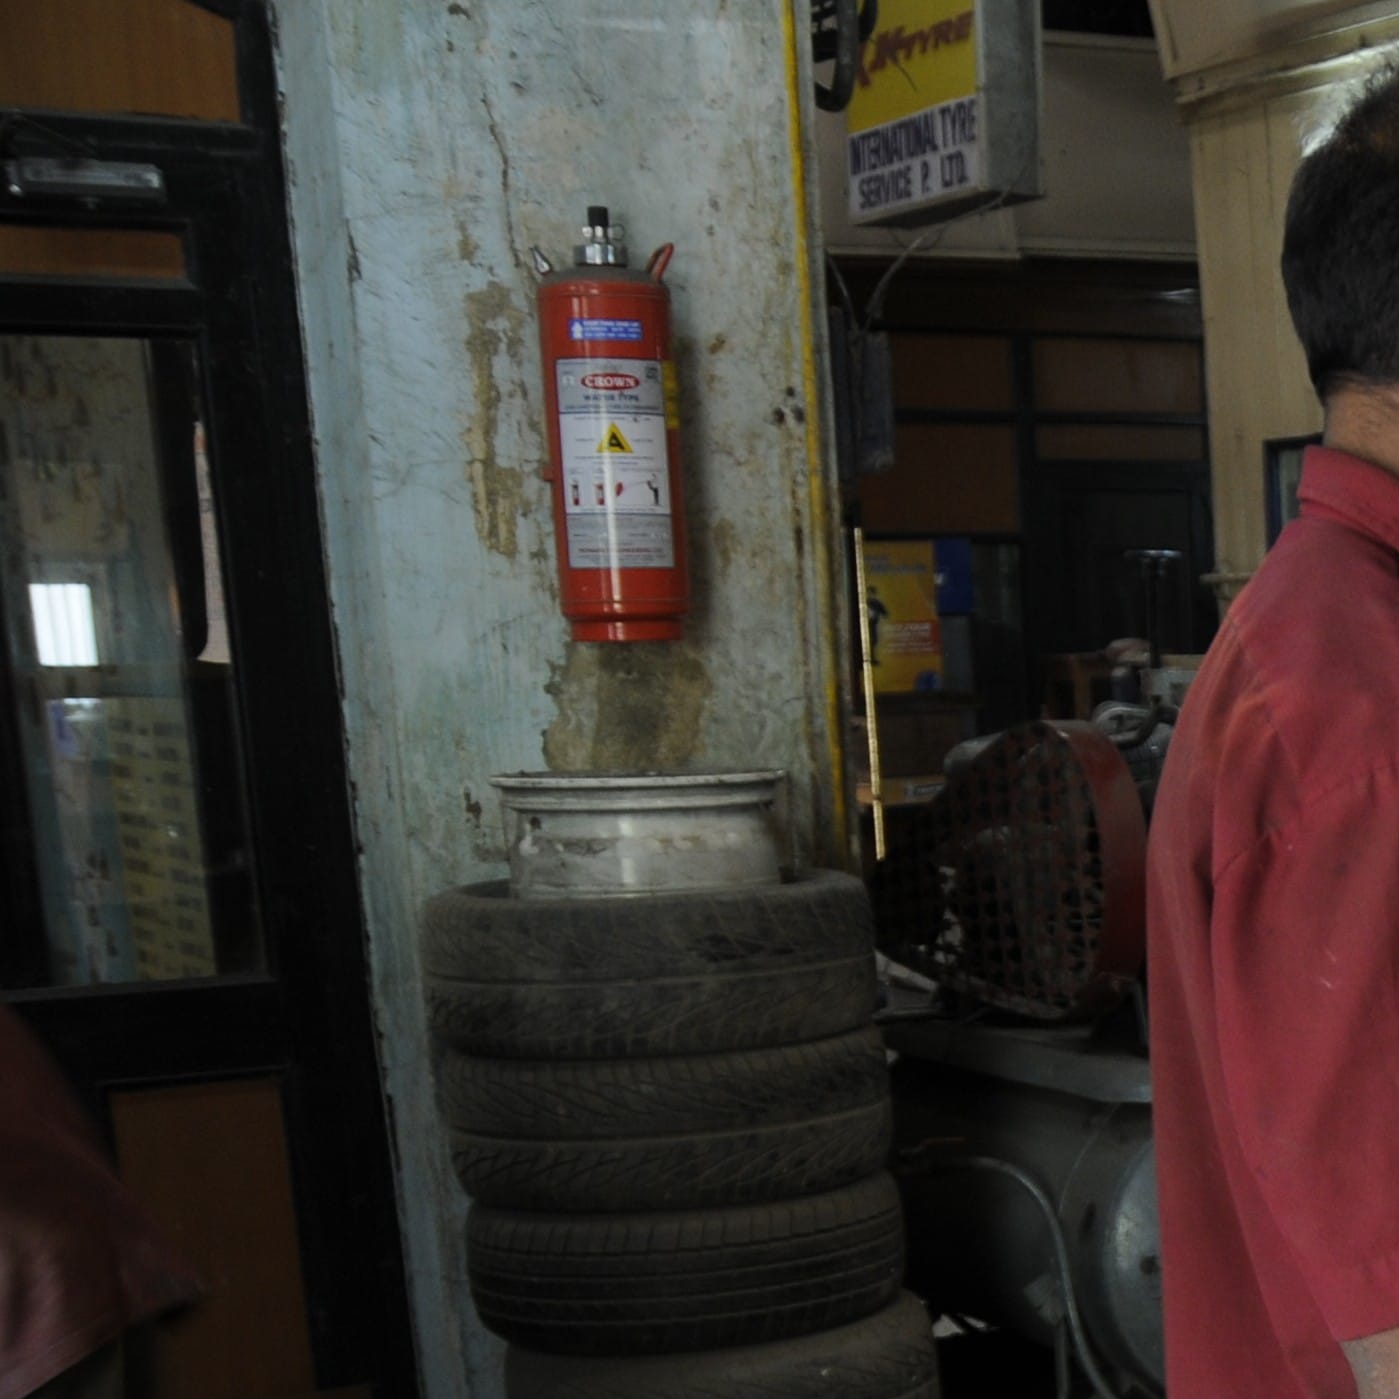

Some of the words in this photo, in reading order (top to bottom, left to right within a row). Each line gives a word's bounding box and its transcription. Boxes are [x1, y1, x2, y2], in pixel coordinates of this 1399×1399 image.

[850, 110, 938, 176] INTERNATIONAL
[939, 98, 977, 148] TYRE
[859, 164, 912, 210] SERVICE
[584, 375, 636, 387] CROWN
